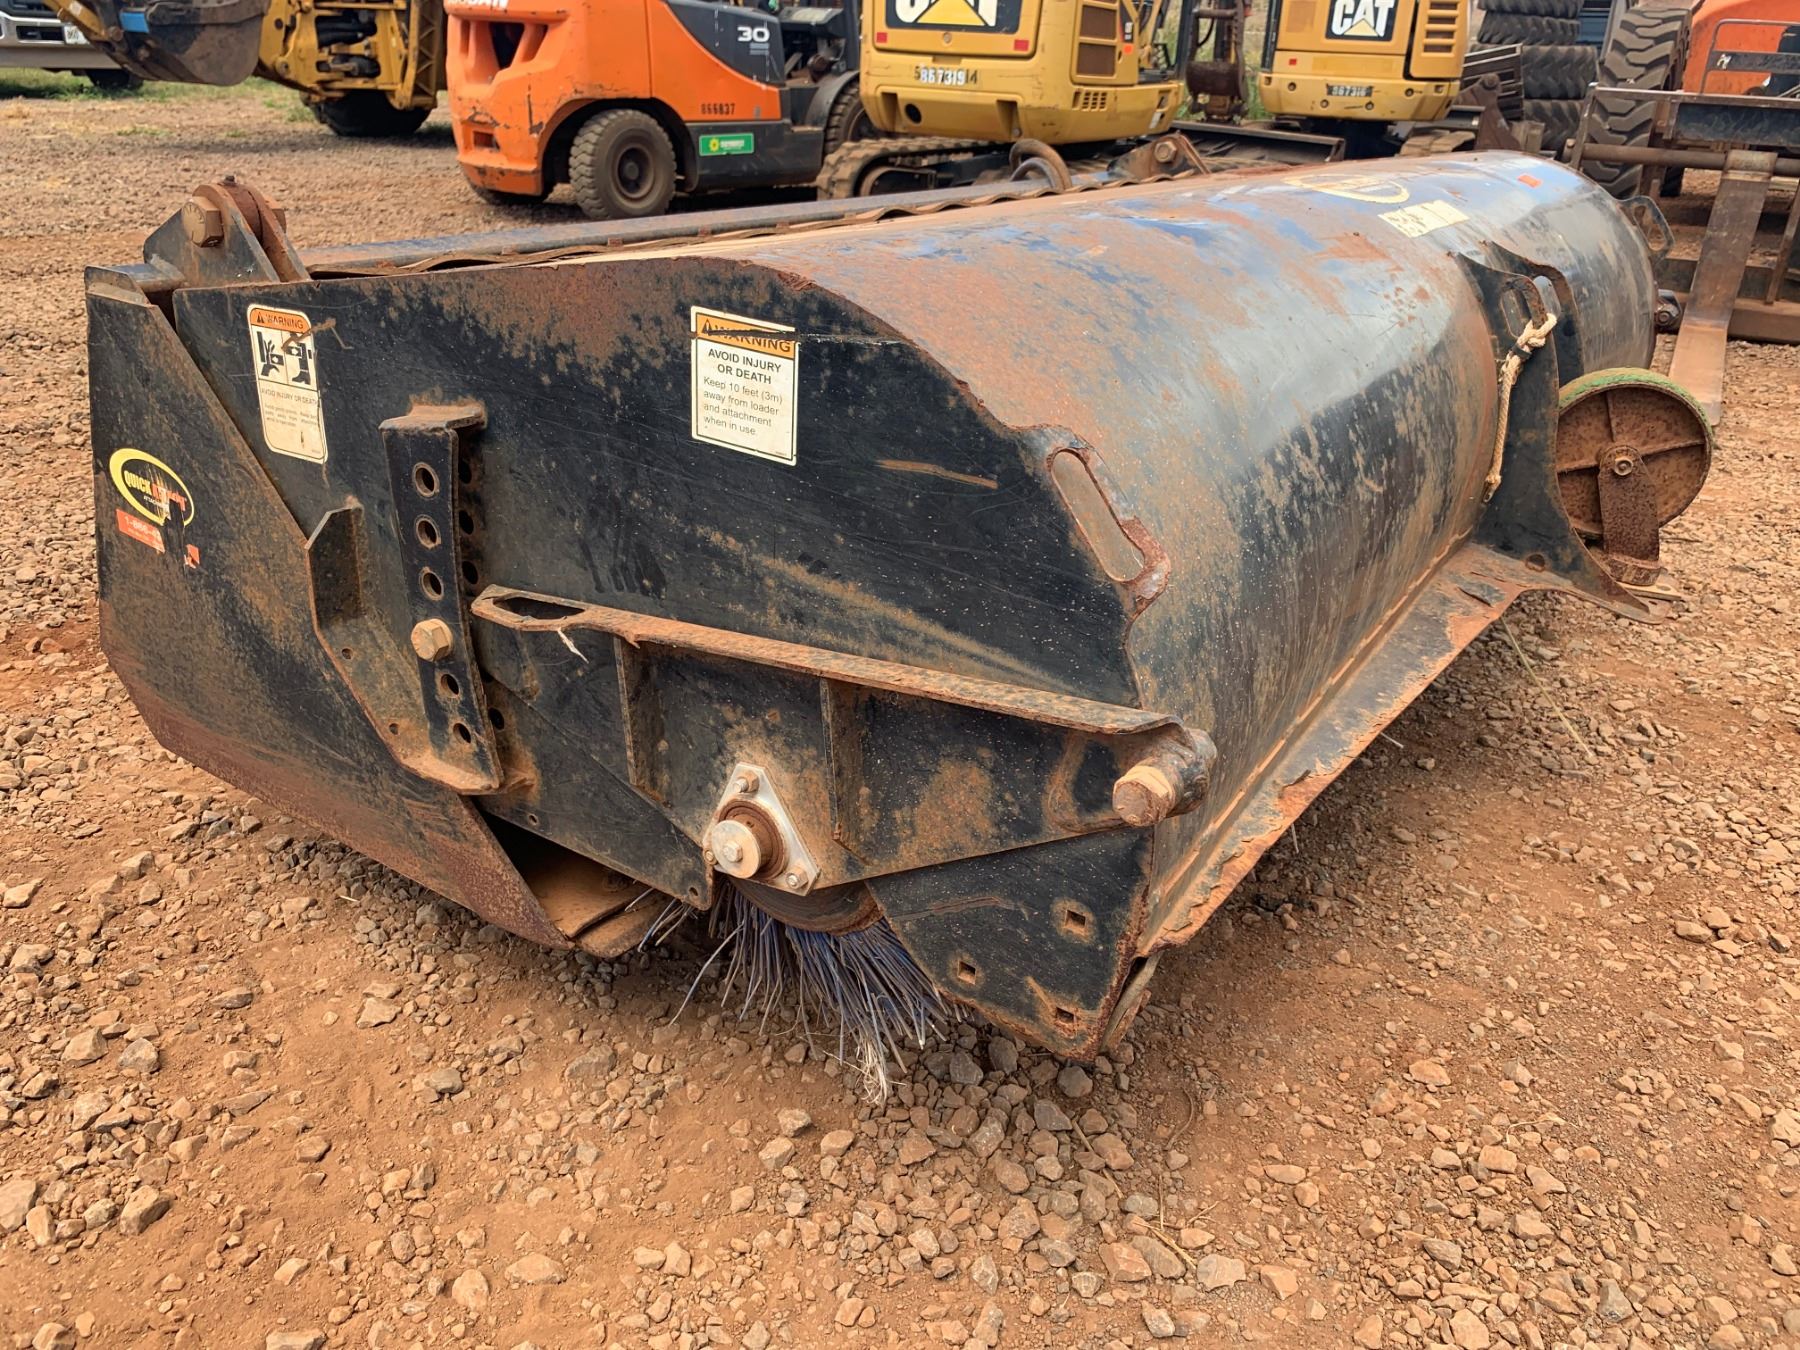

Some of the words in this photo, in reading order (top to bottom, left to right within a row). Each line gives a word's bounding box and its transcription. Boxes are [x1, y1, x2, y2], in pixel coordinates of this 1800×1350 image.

[1332, 0, 1395, 37] CAT
[737, 26, 770, 42] 30
[708, 348, 740, 363] AVOID
[742, 356, 782, 373] INJURY
[717, 363, 733, 375] OR
[735, 368, 772, 385] DEATH
[703, 376, 726, 390] Keep
[729, 382, 740, 393] 10
[742, 386, 759, 397] feet
[761, 391, 783, 405] (3m)
[703, 391, 726, 404] away
[728, 395, 748, 408] from
[750, 401, 779, 415] loader
[703, 403, 720, 413] and
[722, 408, 772, 427] attachment
[703, 415, 727, 428] when
[729, 423, 737, 431] in
[740, 426, 756, 435] use
